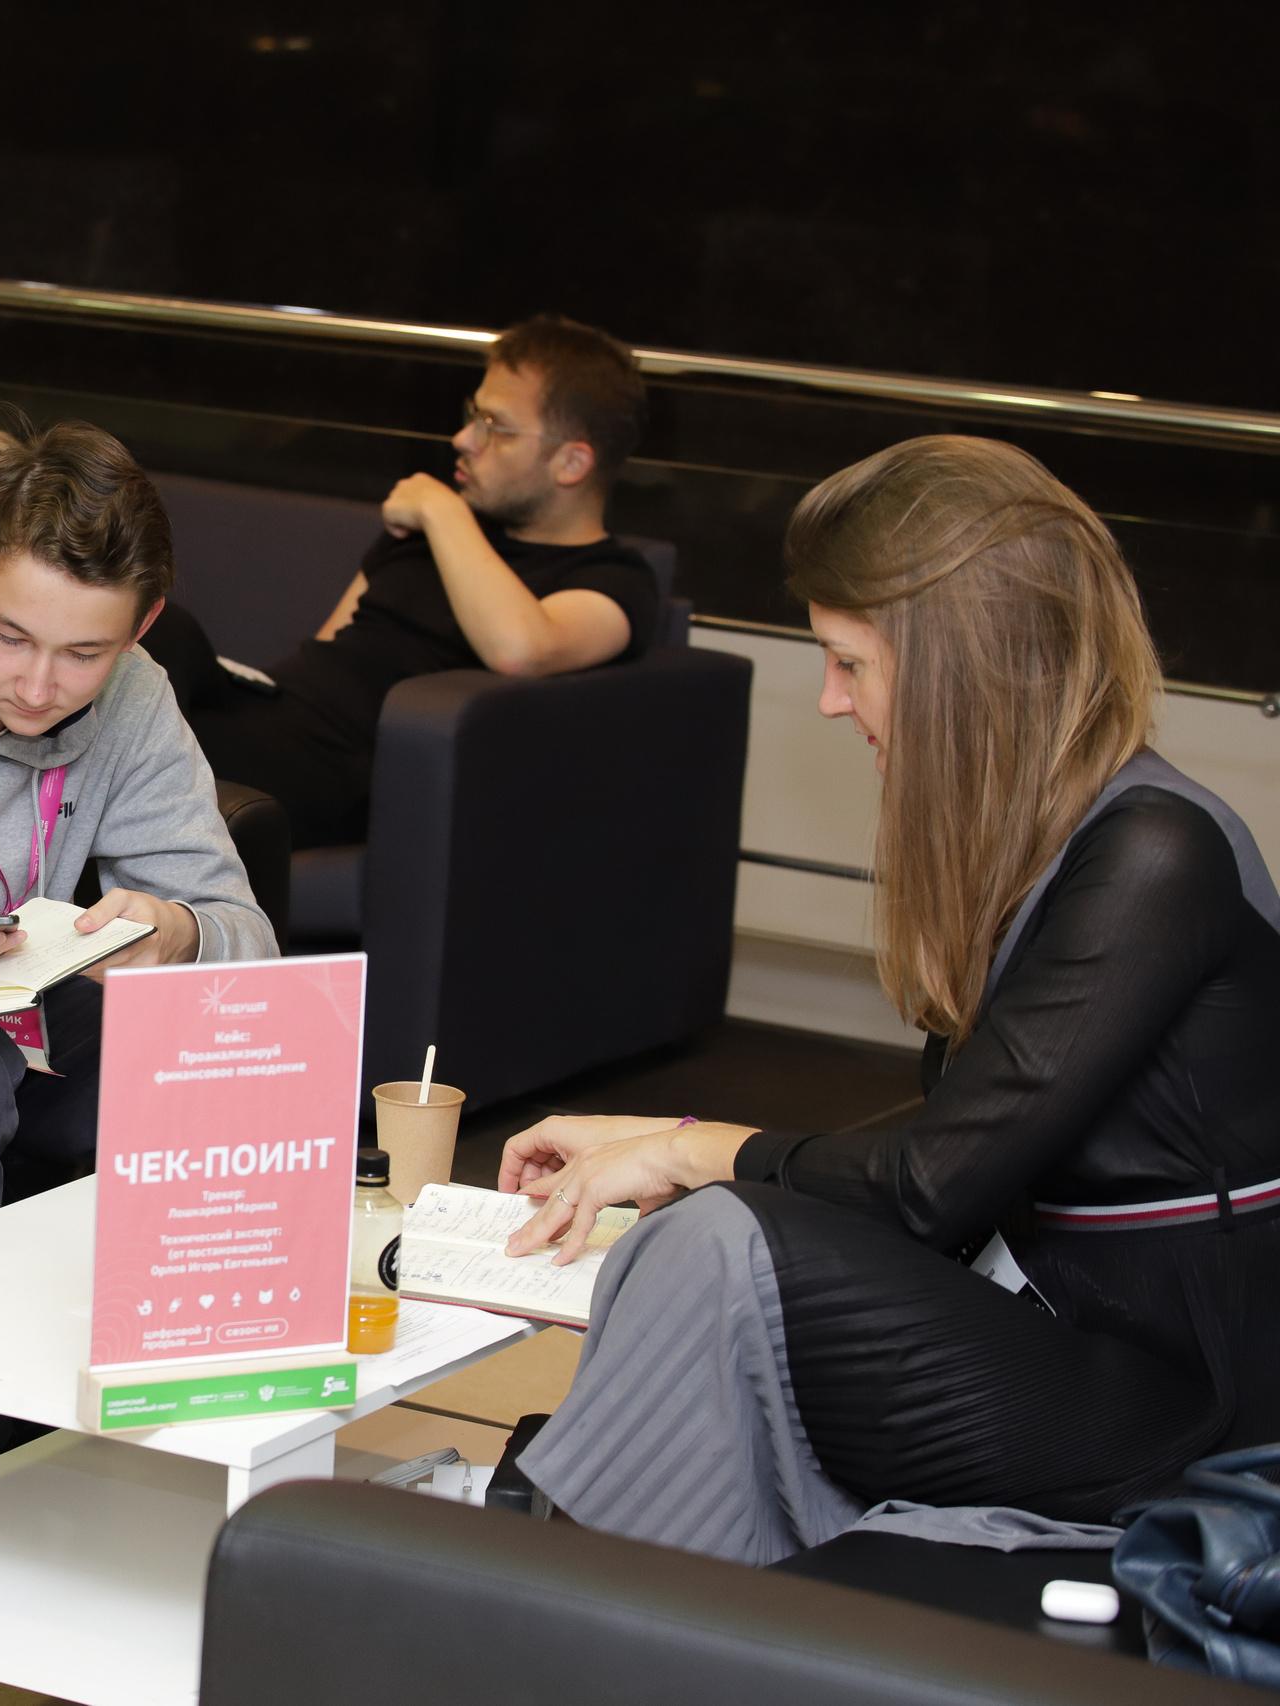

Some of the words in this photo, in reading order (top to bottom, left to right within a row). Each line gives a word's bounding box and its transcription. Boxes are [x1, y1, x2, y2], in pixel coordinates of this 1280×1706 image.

[215, 1030, 251, 1044] Кейс:
[179, 1044, 281, 1065] Проанализируй
[154, 1067, 234, 1085] финансовое
[237, 1061, 307, 1077] поведение
[114, 1137, 335, 1185] ЧЕК-ПОИНТ
[235, 1201, 277, 1214] Марина
[160, 1228, 232, 1245] Технический
[235, 1227, 282, 1241] эксперт:
[168, 1248, 184, 1261] (от
[187, 1240, 272, 1258] постановщика)
[150, 1264, 187, 1278] Орлов
[189, 1260, 222, 1273] Игорь
[224, 1256, 288, 1270] Евгеньевич
[142, 1325, 202, 1341] цифровой
[225, 1325, 262, 1337] сезон:
[142, 1338, 187, 1350] прорыв
